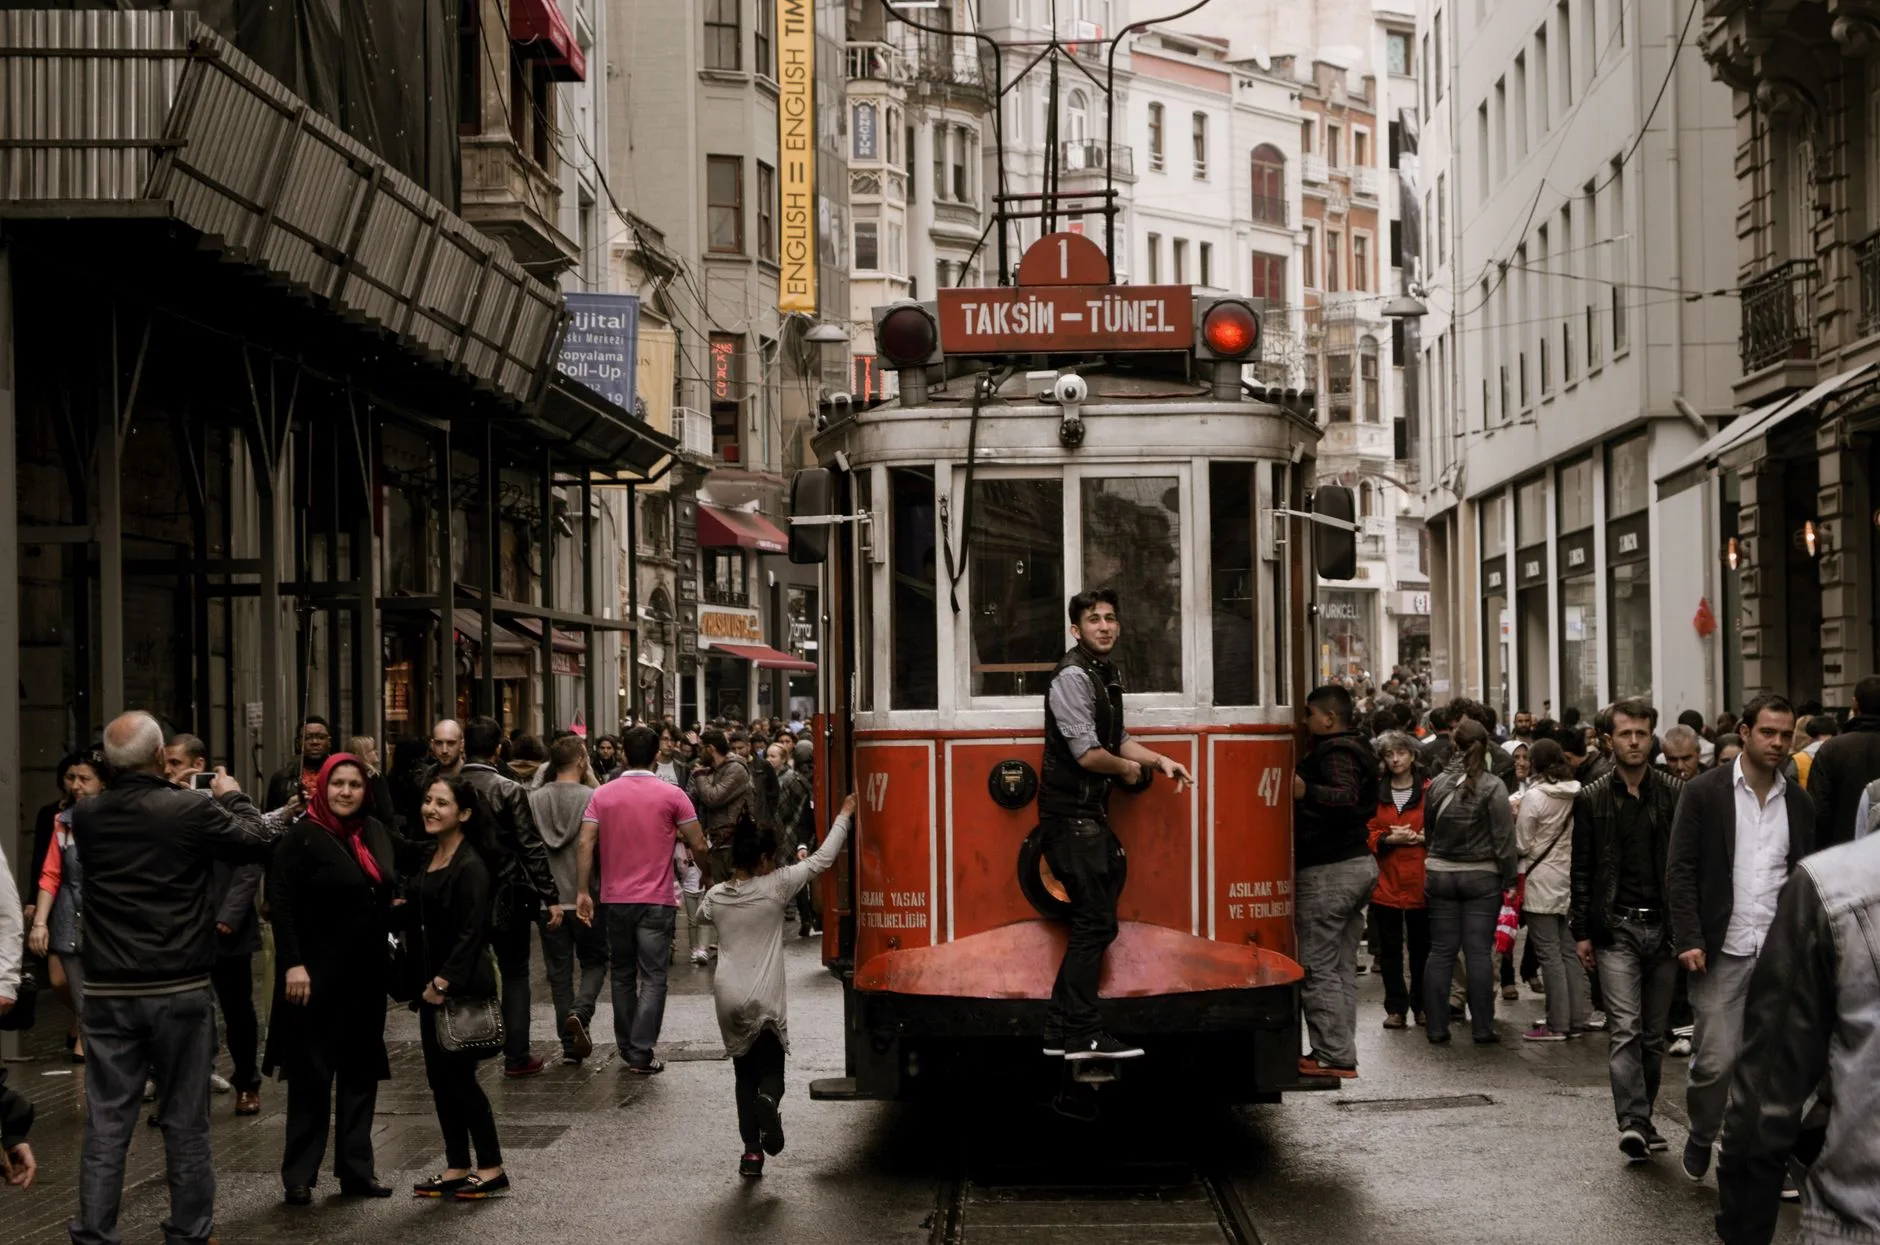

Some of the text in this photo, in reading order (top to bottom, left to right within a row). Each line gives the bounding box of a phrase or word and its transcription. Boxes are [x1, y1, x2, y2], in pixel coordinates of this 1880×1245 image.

[784, 48, 806, 151] ENGLISH
[784, 193, 807, 295] ENGLISH
[1057, 239, 1068, 280] 1
[569, 312, 625, 331] ijital
[960, 295, 1055, 335] TAKSİM
[1086, 294, 1175, 333] TÜNEL
[586, 334, 625, 345] Merkezi
[557, 362, 621, 381] Roll-Up
[866, 772, 889, 812] 47
[1257, 767, 1282, 806] 47
[860, 890, 926, 907] SILMAK YASAK
[1228, 880, 1273, 898] ASILMAK
[1228, 903, 1245, 920] VE
